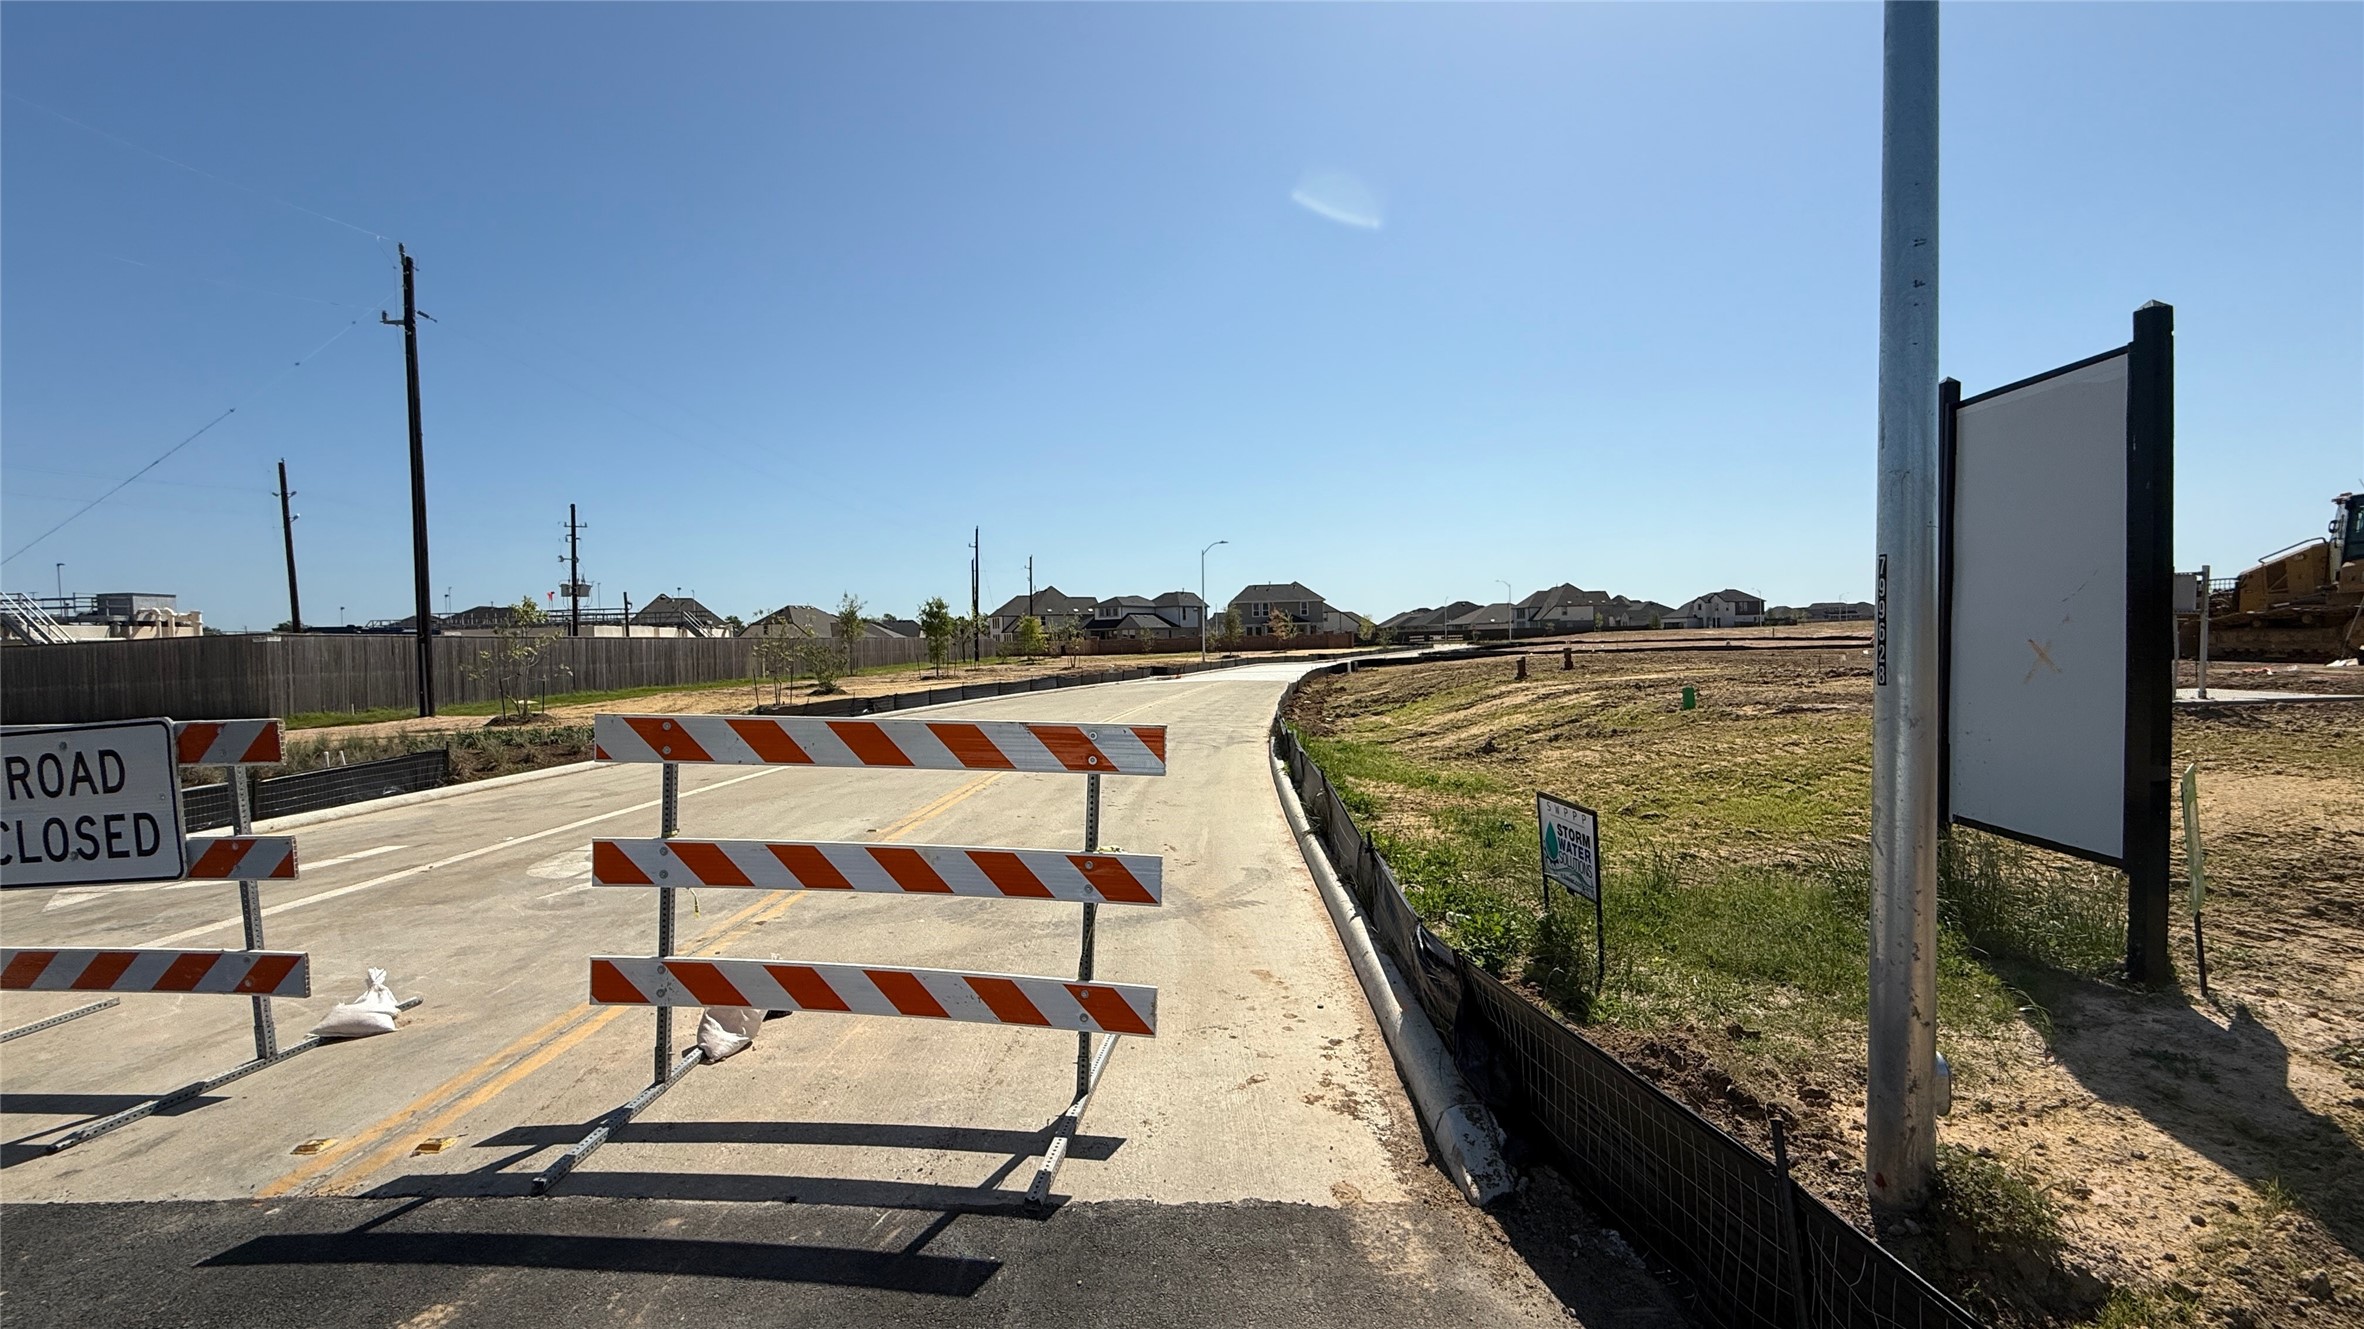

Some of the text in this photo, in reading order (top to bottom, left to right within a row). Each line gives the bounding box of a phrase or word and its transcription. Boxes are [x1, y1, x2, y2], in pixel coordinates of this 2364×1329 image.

[1878, 555, 1886, 684] 799628
[5, 749, 126, 800] ROAD
[1556, 823, 1590, 849] STORM
[1558, 837, 1591, 863] WATER
[1559, 851, 1593, 879] SOLUTIONS
